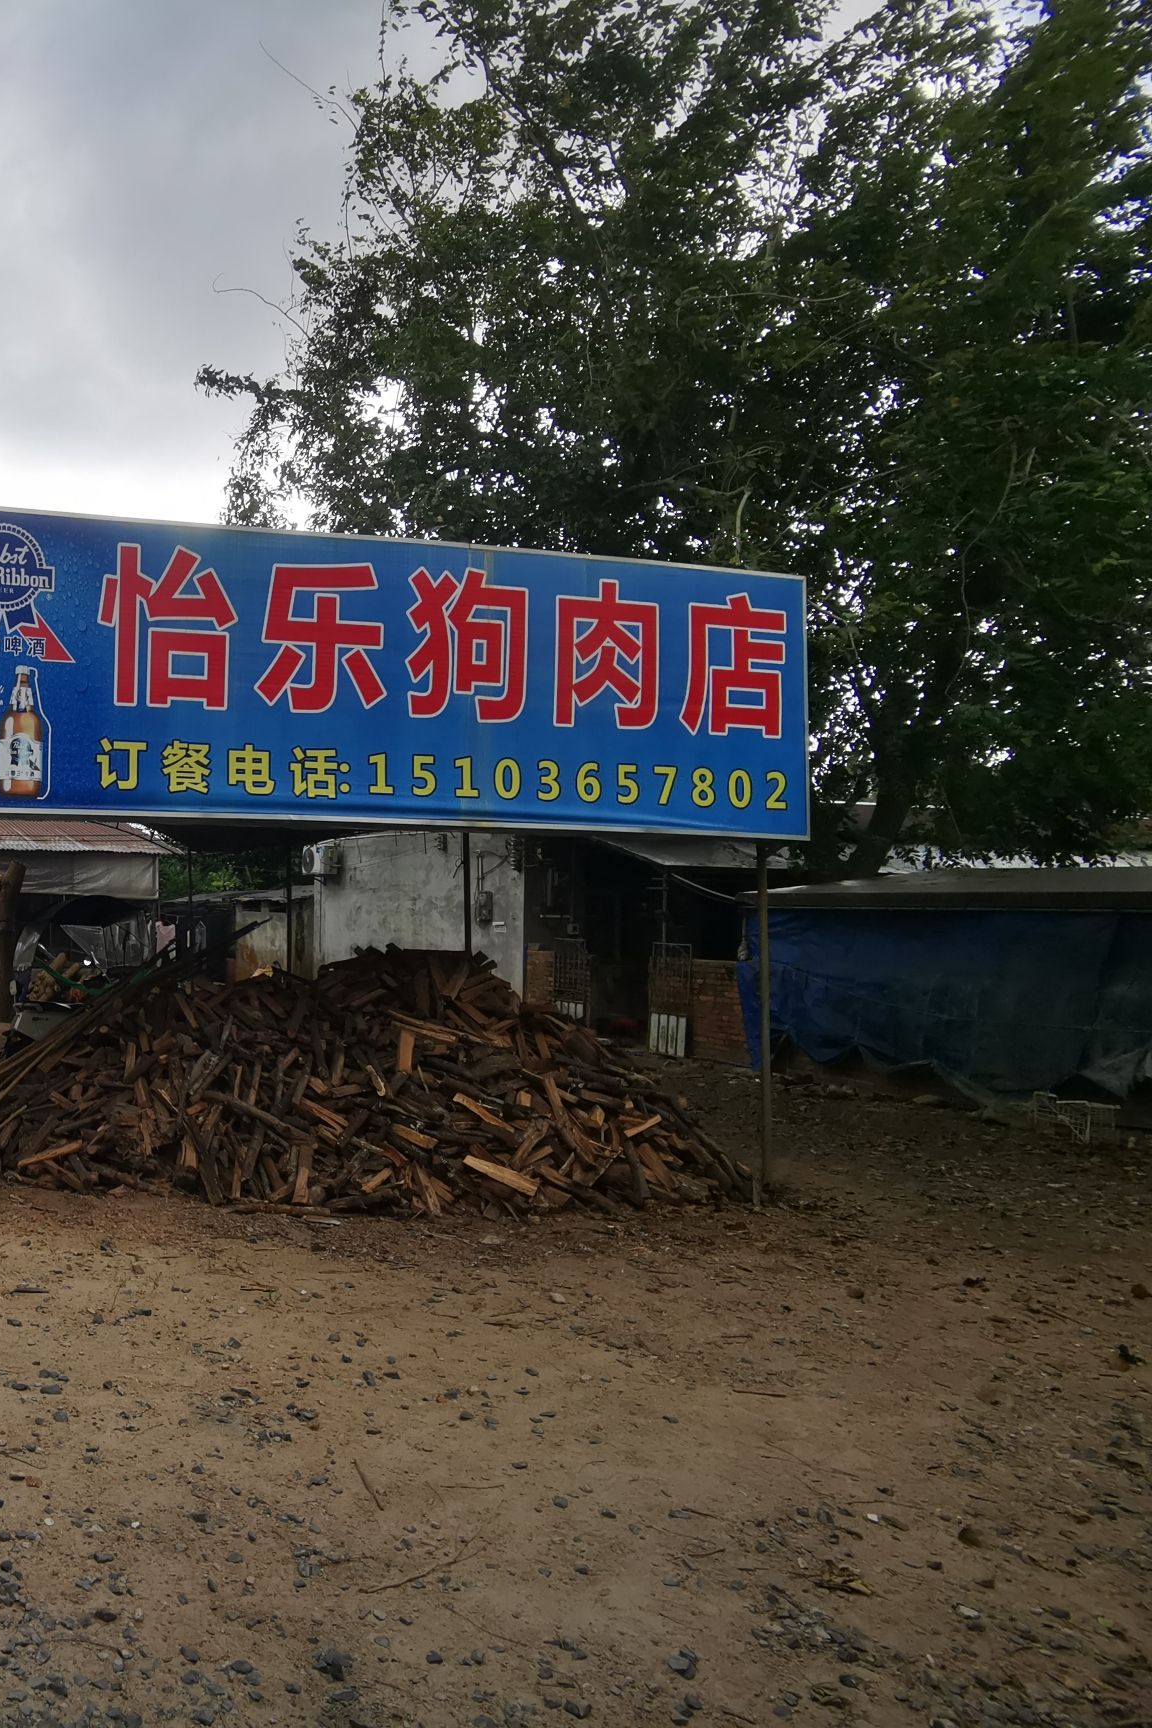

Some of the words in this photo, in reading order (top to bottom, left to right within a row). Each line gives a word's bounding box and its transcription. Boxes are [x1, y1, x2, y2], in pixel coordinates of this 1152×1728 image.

[97, 542, 788, 740] 怡乐狗肉店
